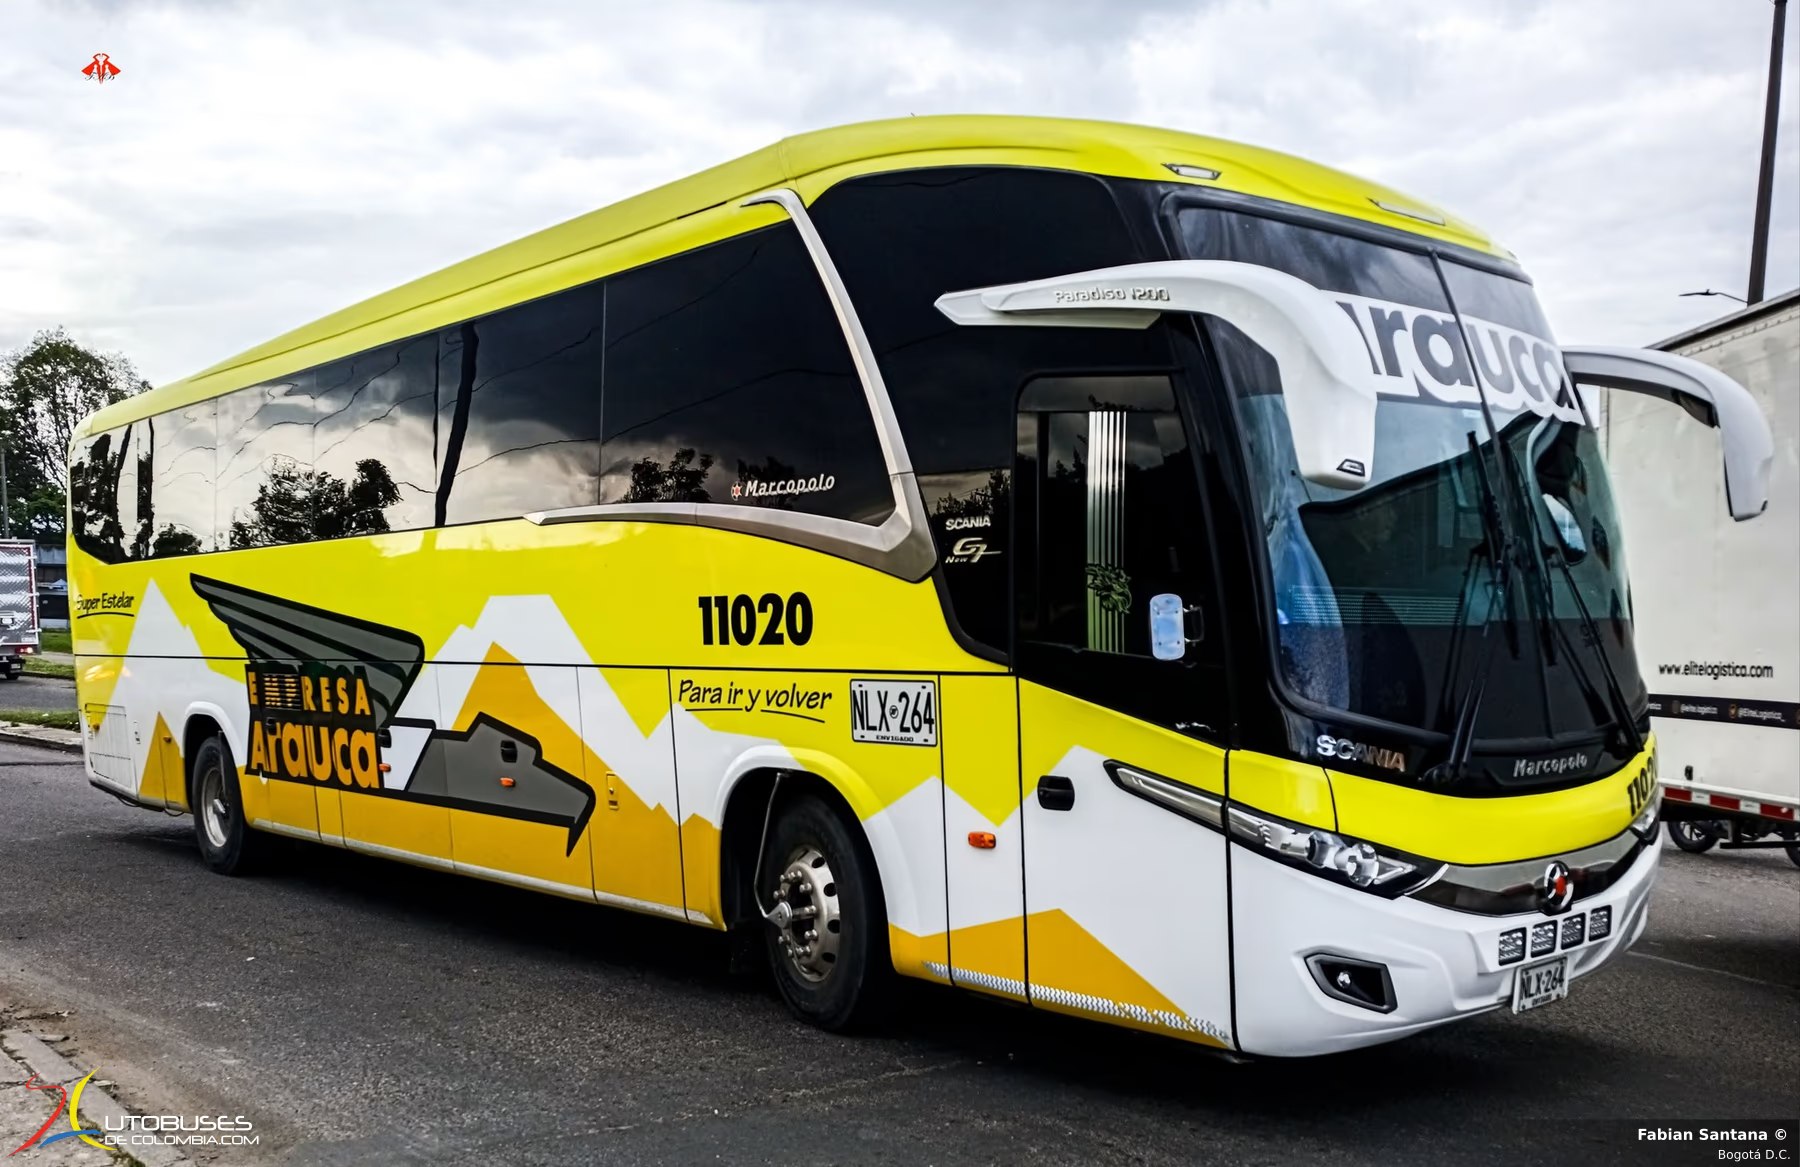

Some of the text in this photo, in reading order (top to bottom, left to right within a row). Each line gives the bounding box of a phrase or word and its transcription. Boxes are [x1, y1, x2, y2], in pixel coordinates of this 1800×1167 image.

[1055, 286, 1170, 303] Paradiso 1200
[744, 473, 836, 497] Marcopolo
[945, 515, 992, 531] SCANIA
[76, 591, 134, 615] Super Estelar
[698, 591, 814, 646] 11020
[1658, 661, 1774, 680] www.elitelogistica.com
[678, 679, 833, 712] Para ir y volver
[852, 689, 935, 735] NLX 264
[251, 720, 380, 789] Arauca
[1316, 734, 1405, 772] SCANIA
[1513, 751, 1588, 778] Marcopolo
[1520, 972, 1544, 1000] NLX
[1544, 966, 1565, 993] 264
